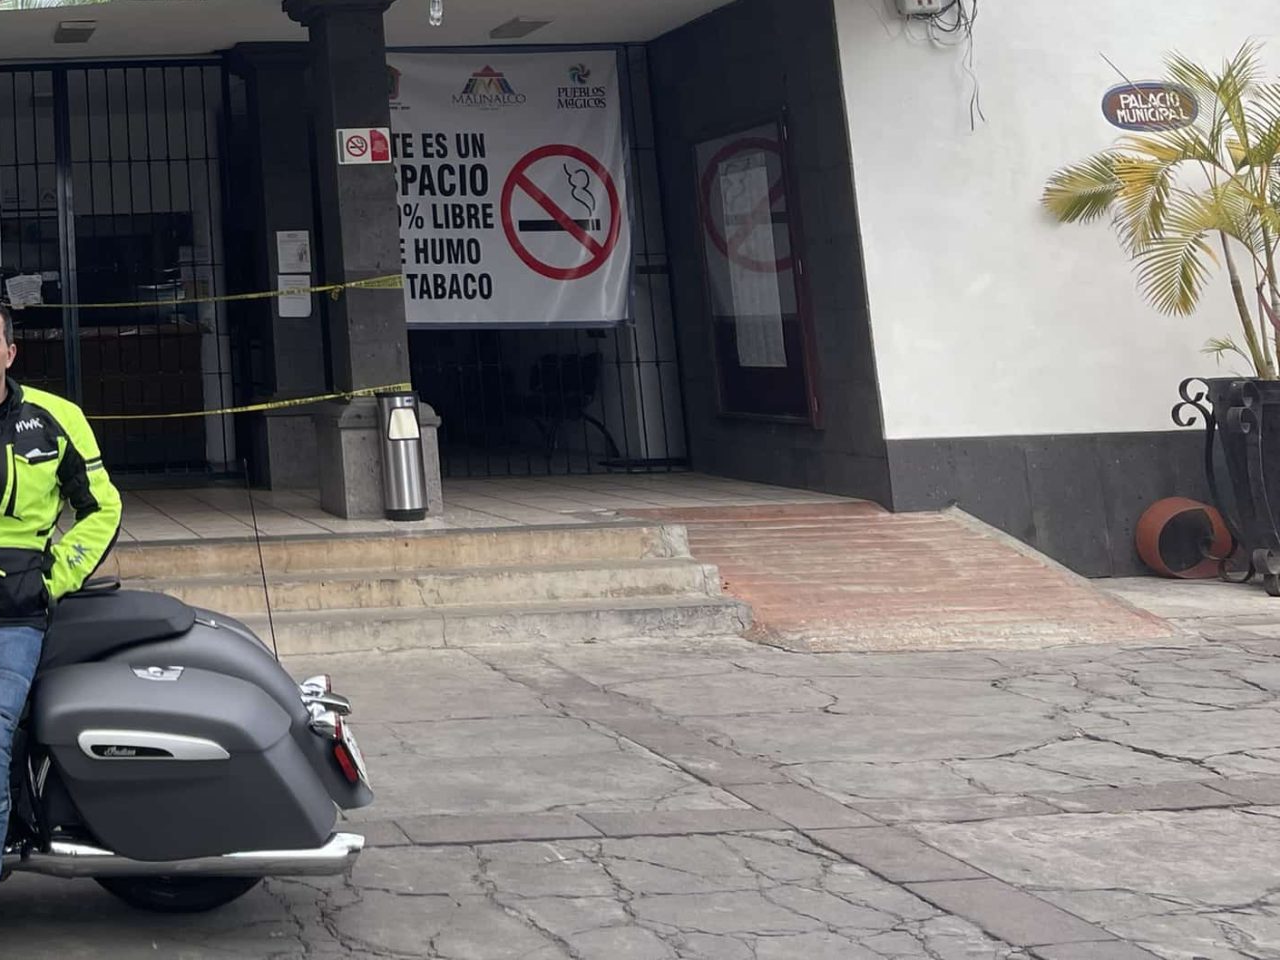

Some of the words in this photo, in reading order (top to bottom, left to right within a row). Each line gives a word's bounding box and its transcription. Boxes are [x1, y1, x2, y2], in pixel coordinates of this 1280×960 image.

[451, 93, 527, 105] MALINALCO
[1120, 92, 1180, 109] PALACIO
[1117, 107, 1190, 124] MUNICIPAL
[422, 133, 448, 158] ES
[456, 133, 486, 158] UN
[431, 203, 494, 229] LIBRE
[414, 237, 482, 265] HUMO
[406, 273, 493, 300] TABACO
